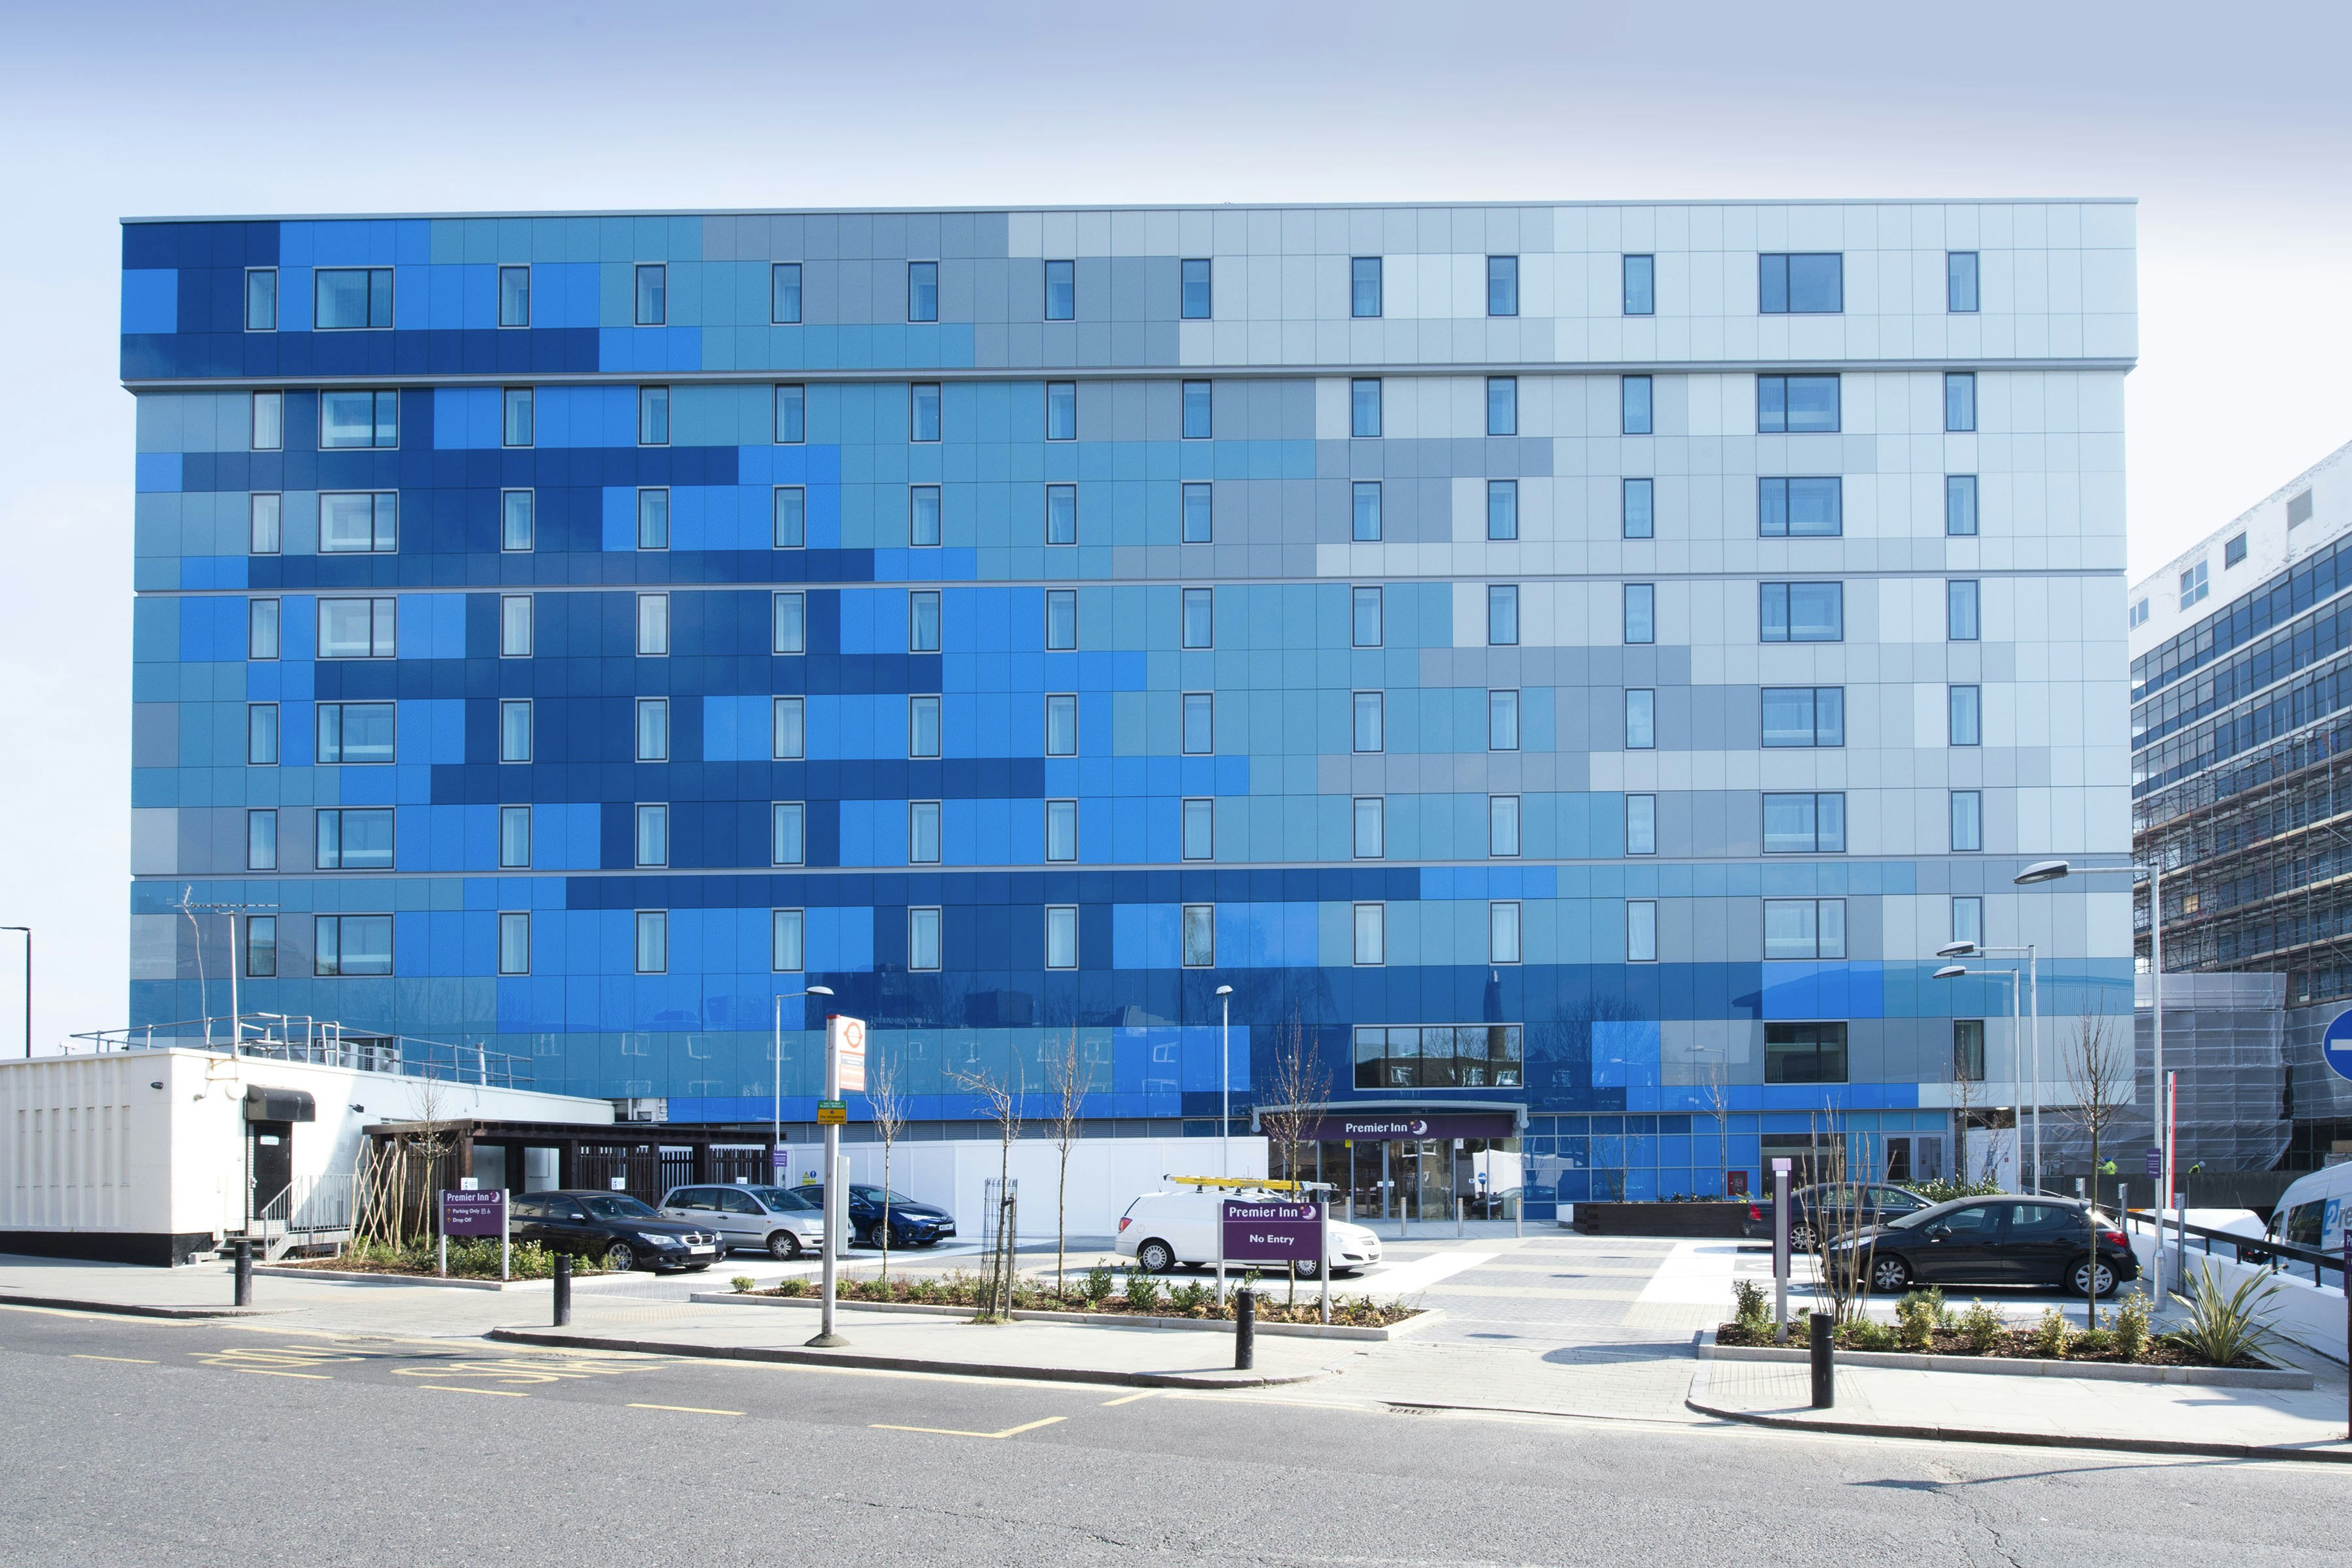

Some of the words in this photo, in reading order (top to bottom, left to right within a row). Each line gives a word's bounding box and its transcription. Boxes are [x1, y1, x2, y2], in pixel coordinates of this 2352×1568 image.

[1345, 1122, 1389, 1133] Premier
[1390, 1122, 1408, 1132] Inn
[447, 1193, 476, 1201] Premier
[477, 1193, 489, 1201] Inn
[1229, 1207, 1276, 1217] Premier
[1279, 1207, 1298, 1217] Inn
[1249, 1234, 1264, 1243] No
[1267, 1235, 1294, 1246] Entry
